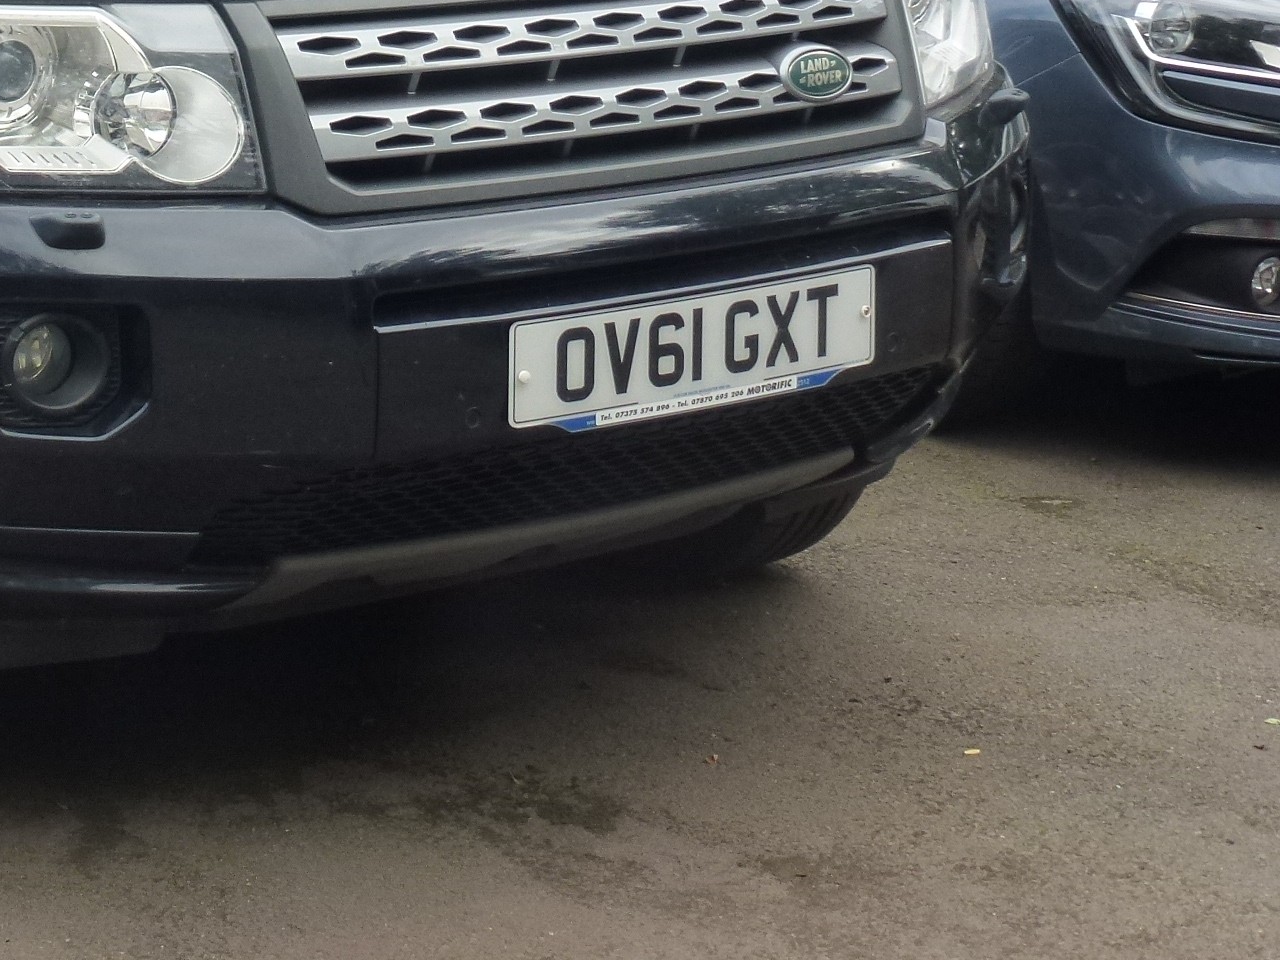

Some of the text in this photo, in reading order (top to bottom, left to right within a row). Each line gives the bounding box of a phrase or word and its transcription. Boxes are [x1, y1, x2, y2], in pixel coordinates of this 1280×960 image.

[800, 57, 830, 74] LAND
[807, 69, 842, 87] ROVER
[556, 283, 839, 403] OV61 GXT
[746, 378, 793, 396] MOTORIFIC
